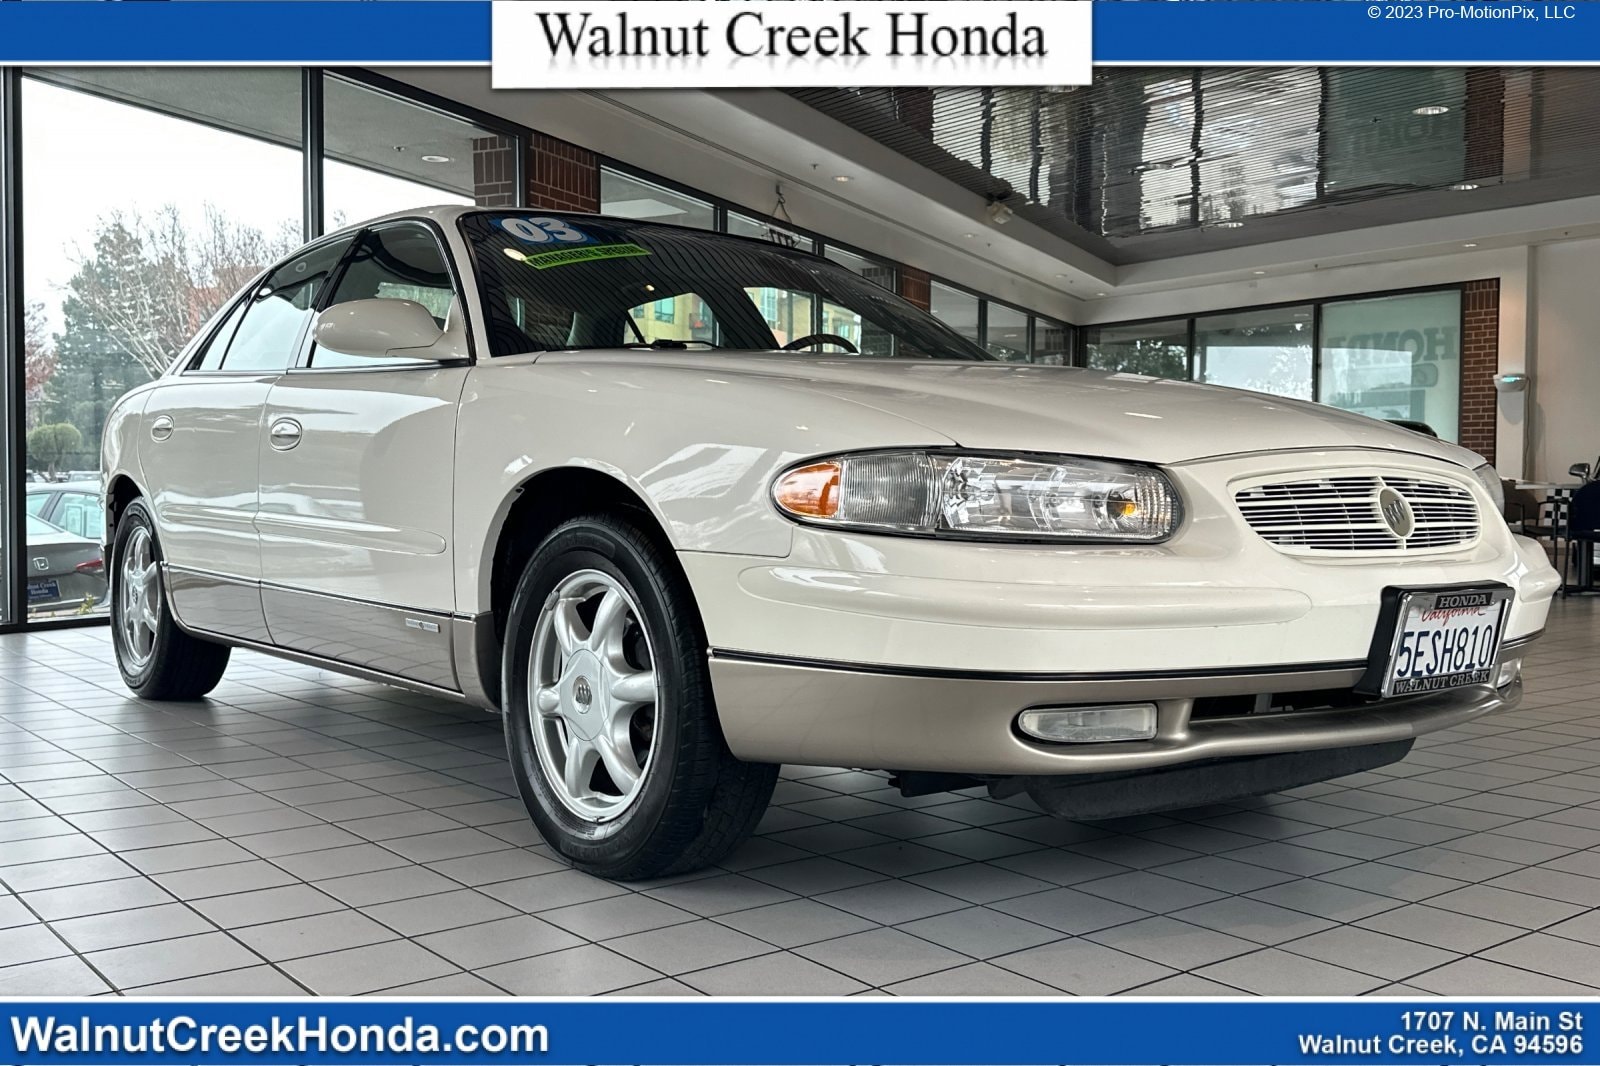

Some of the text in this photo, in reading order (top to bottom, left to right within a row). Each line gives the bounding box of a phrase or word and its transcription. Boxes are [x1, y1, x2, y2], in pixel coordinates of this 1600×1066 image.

[501, 216, 587, 243] 03
[1438, 594, 1488, 608] HONDA
[1396, 625, 1493, 677] 5ESH810
[1395, 670, 1490, 694] WALNUT CREEK
